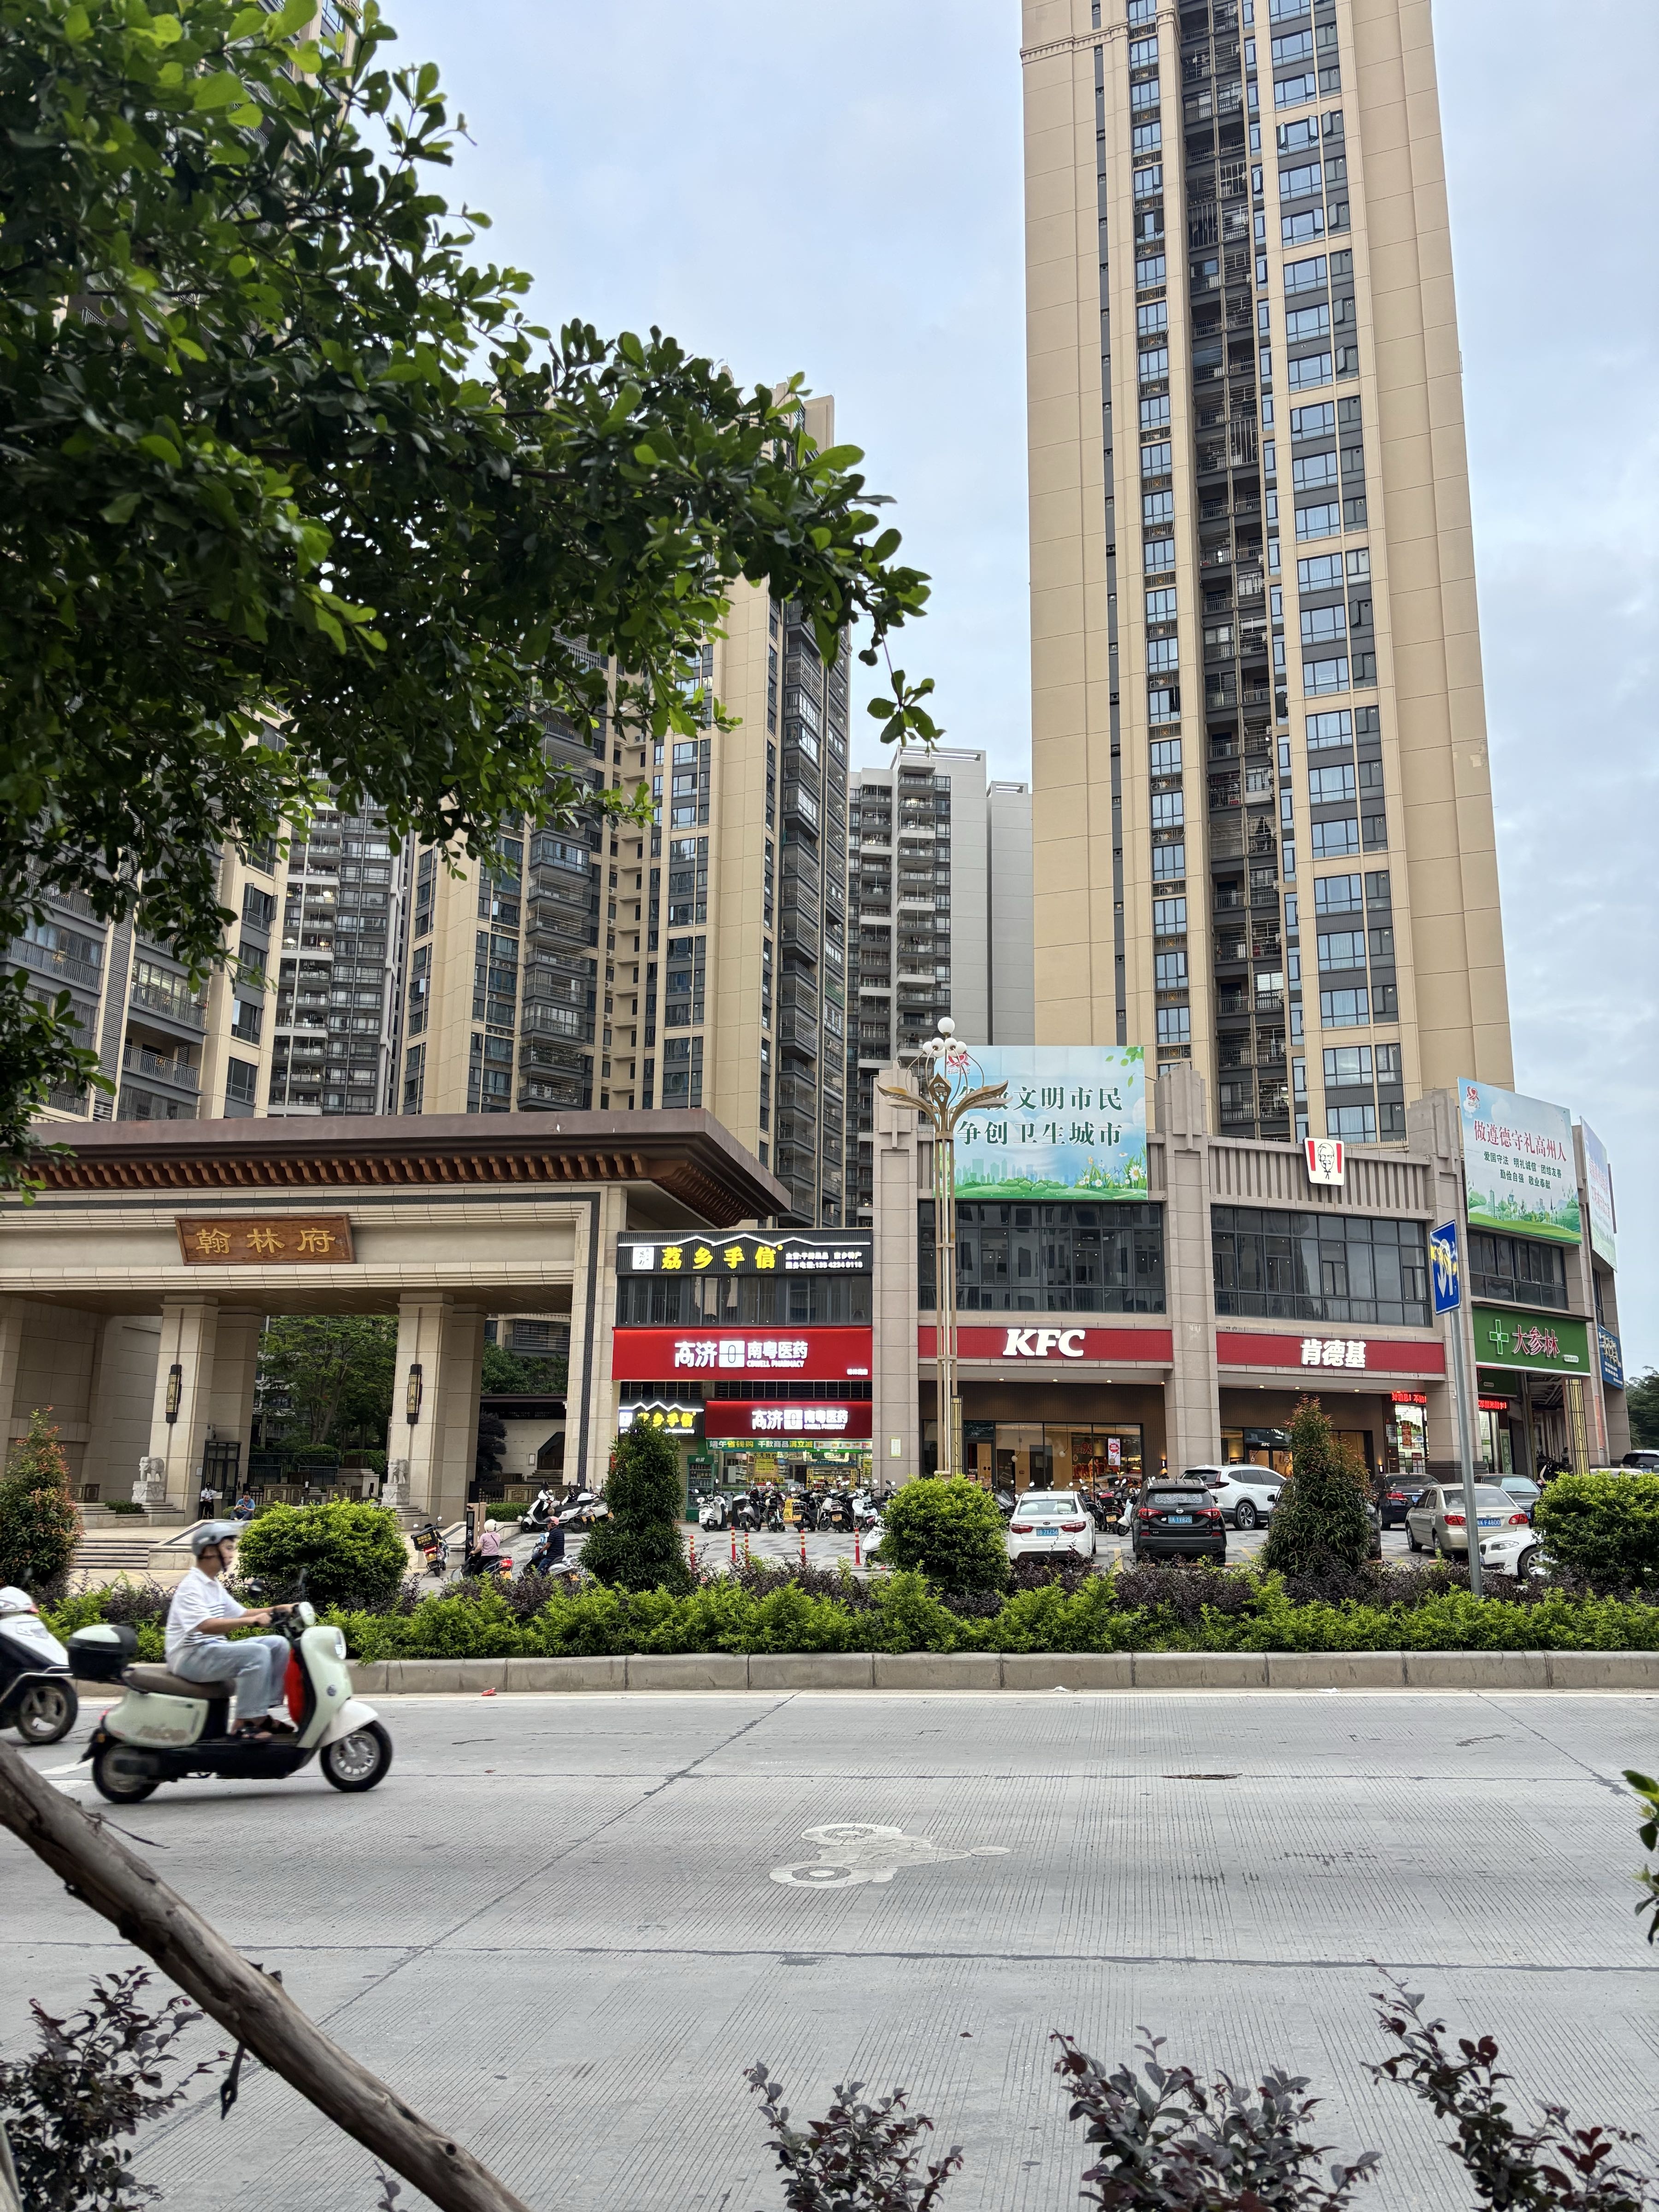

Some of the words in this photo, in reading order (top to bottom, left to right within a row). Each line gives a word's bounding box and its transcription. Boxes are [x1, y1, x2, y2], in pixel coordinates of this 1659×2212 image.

[957, 1086, 1122, 1111] 文明市民
[957, 1121, 1123, 1146] 争创卫生城市
[1474, 1120, 1567, 1162] 做遵德守礼高州人
[1484, 1151, 1509, 1165] 爱国守法
[1513, 1158, 1537, 1172] 明礼诚信
[1541, 1165, 1562, 1178] 团结友善
[1500, 1169, 1524, 1183] 勤俭自强
[1529, 1176, 1551, 1190] 敬业奉献
[196, 1228, 335, 1254] 翰林府
[661, 1246, 777, 1270] 荔乡手信
[675, 1341, 718, 1367] 高济
[747, 1341, 808, 1359] 南粤医药
[1003, 1329, 1085, 1357] KFC
[1301, 1338, 1366, 1368] 肯德基
[1512, 1324, 1560, 1358] 大参林
[752, 1410, 783, 1430] 高济
